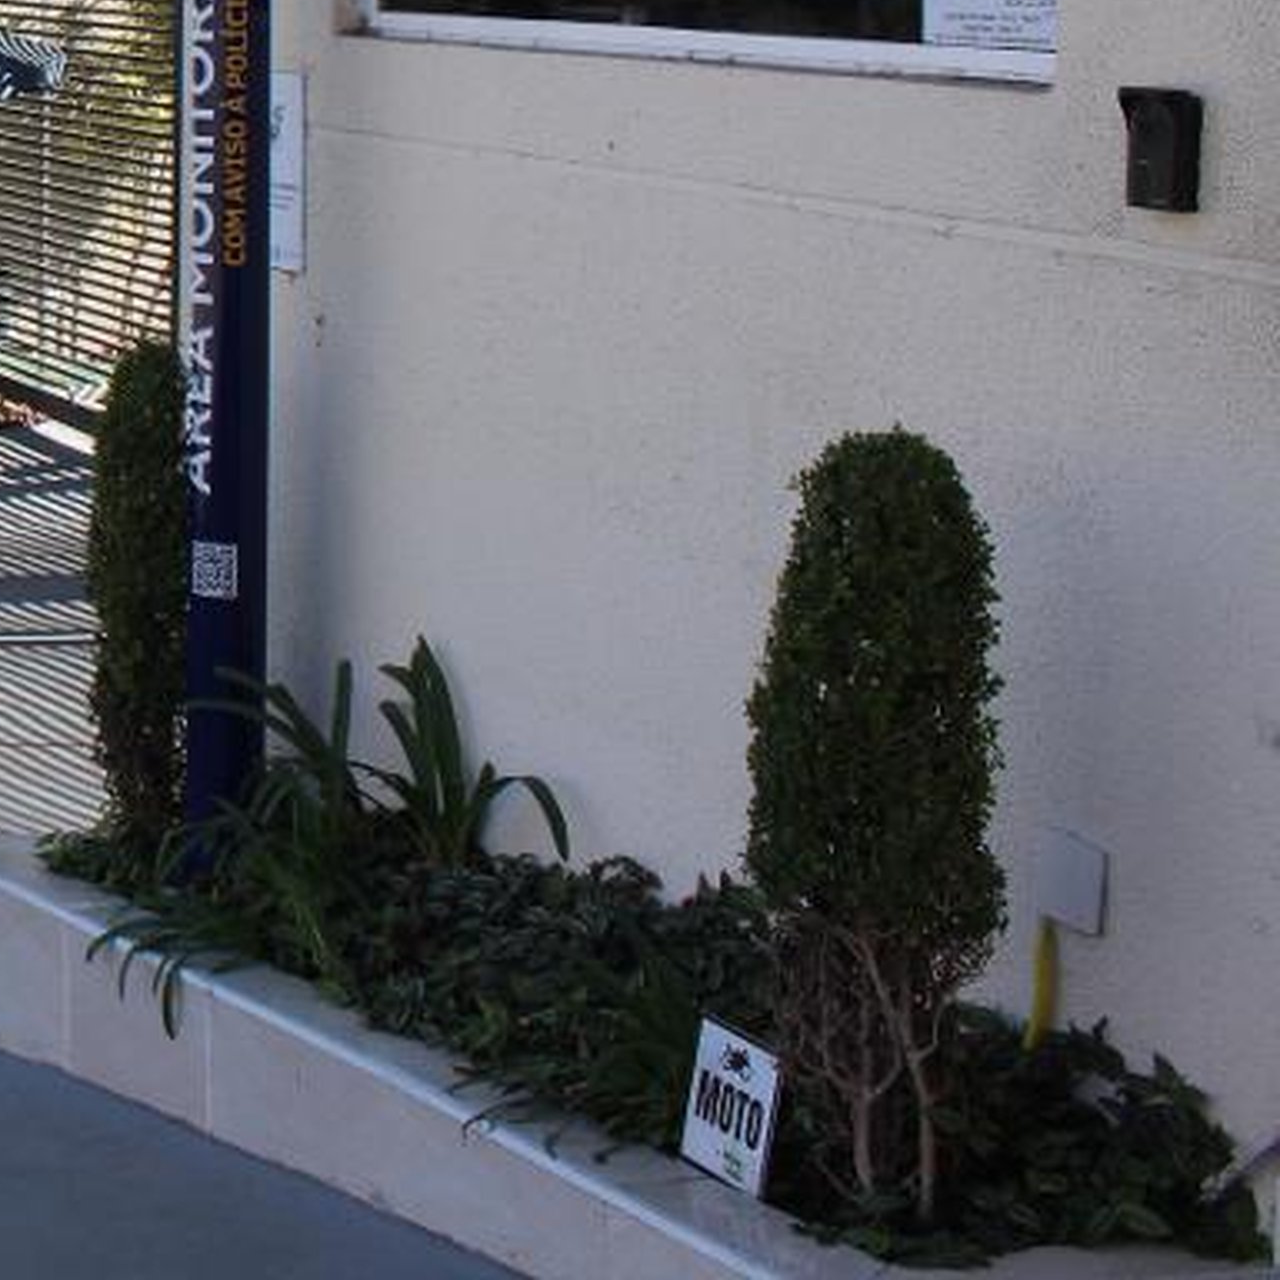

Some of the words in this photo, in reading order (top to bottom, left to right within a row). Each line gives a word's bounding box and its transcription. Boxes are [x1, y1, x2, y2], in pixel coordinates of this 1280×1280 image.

[223, 119, 247, 204] AVISO
[222, 208, 247, 268] COM
[695, 1068, 765, 1152] MOTO
